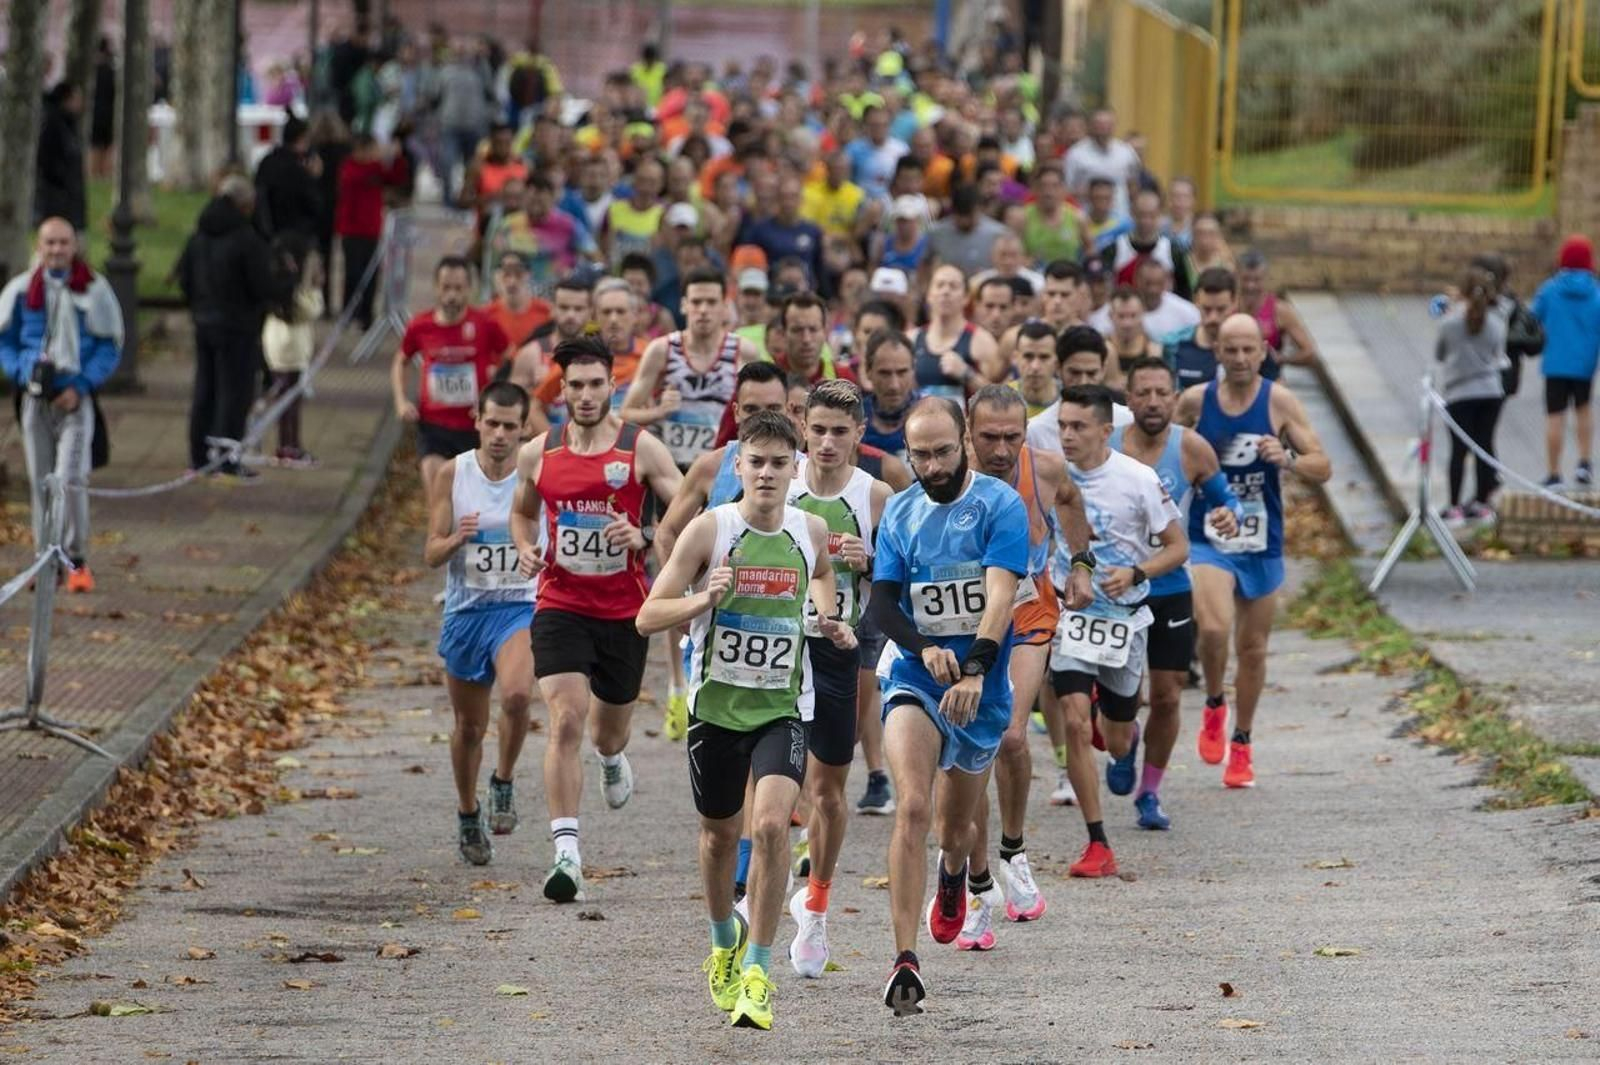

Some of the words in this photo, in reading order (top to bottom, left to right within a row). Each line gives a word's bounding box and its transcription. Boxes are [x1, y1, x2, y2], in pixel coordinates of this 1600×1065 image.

[670, 423, 715, 449] 372
[476, 545, 520, 573] 317
[736, 581, 766, 593] home
[738, 569, 797, 583] mandarina
[920, 580, 986, 616] 316
[1068, 614, 1129, 650] 369
[718, 630, 792, 669] 382
